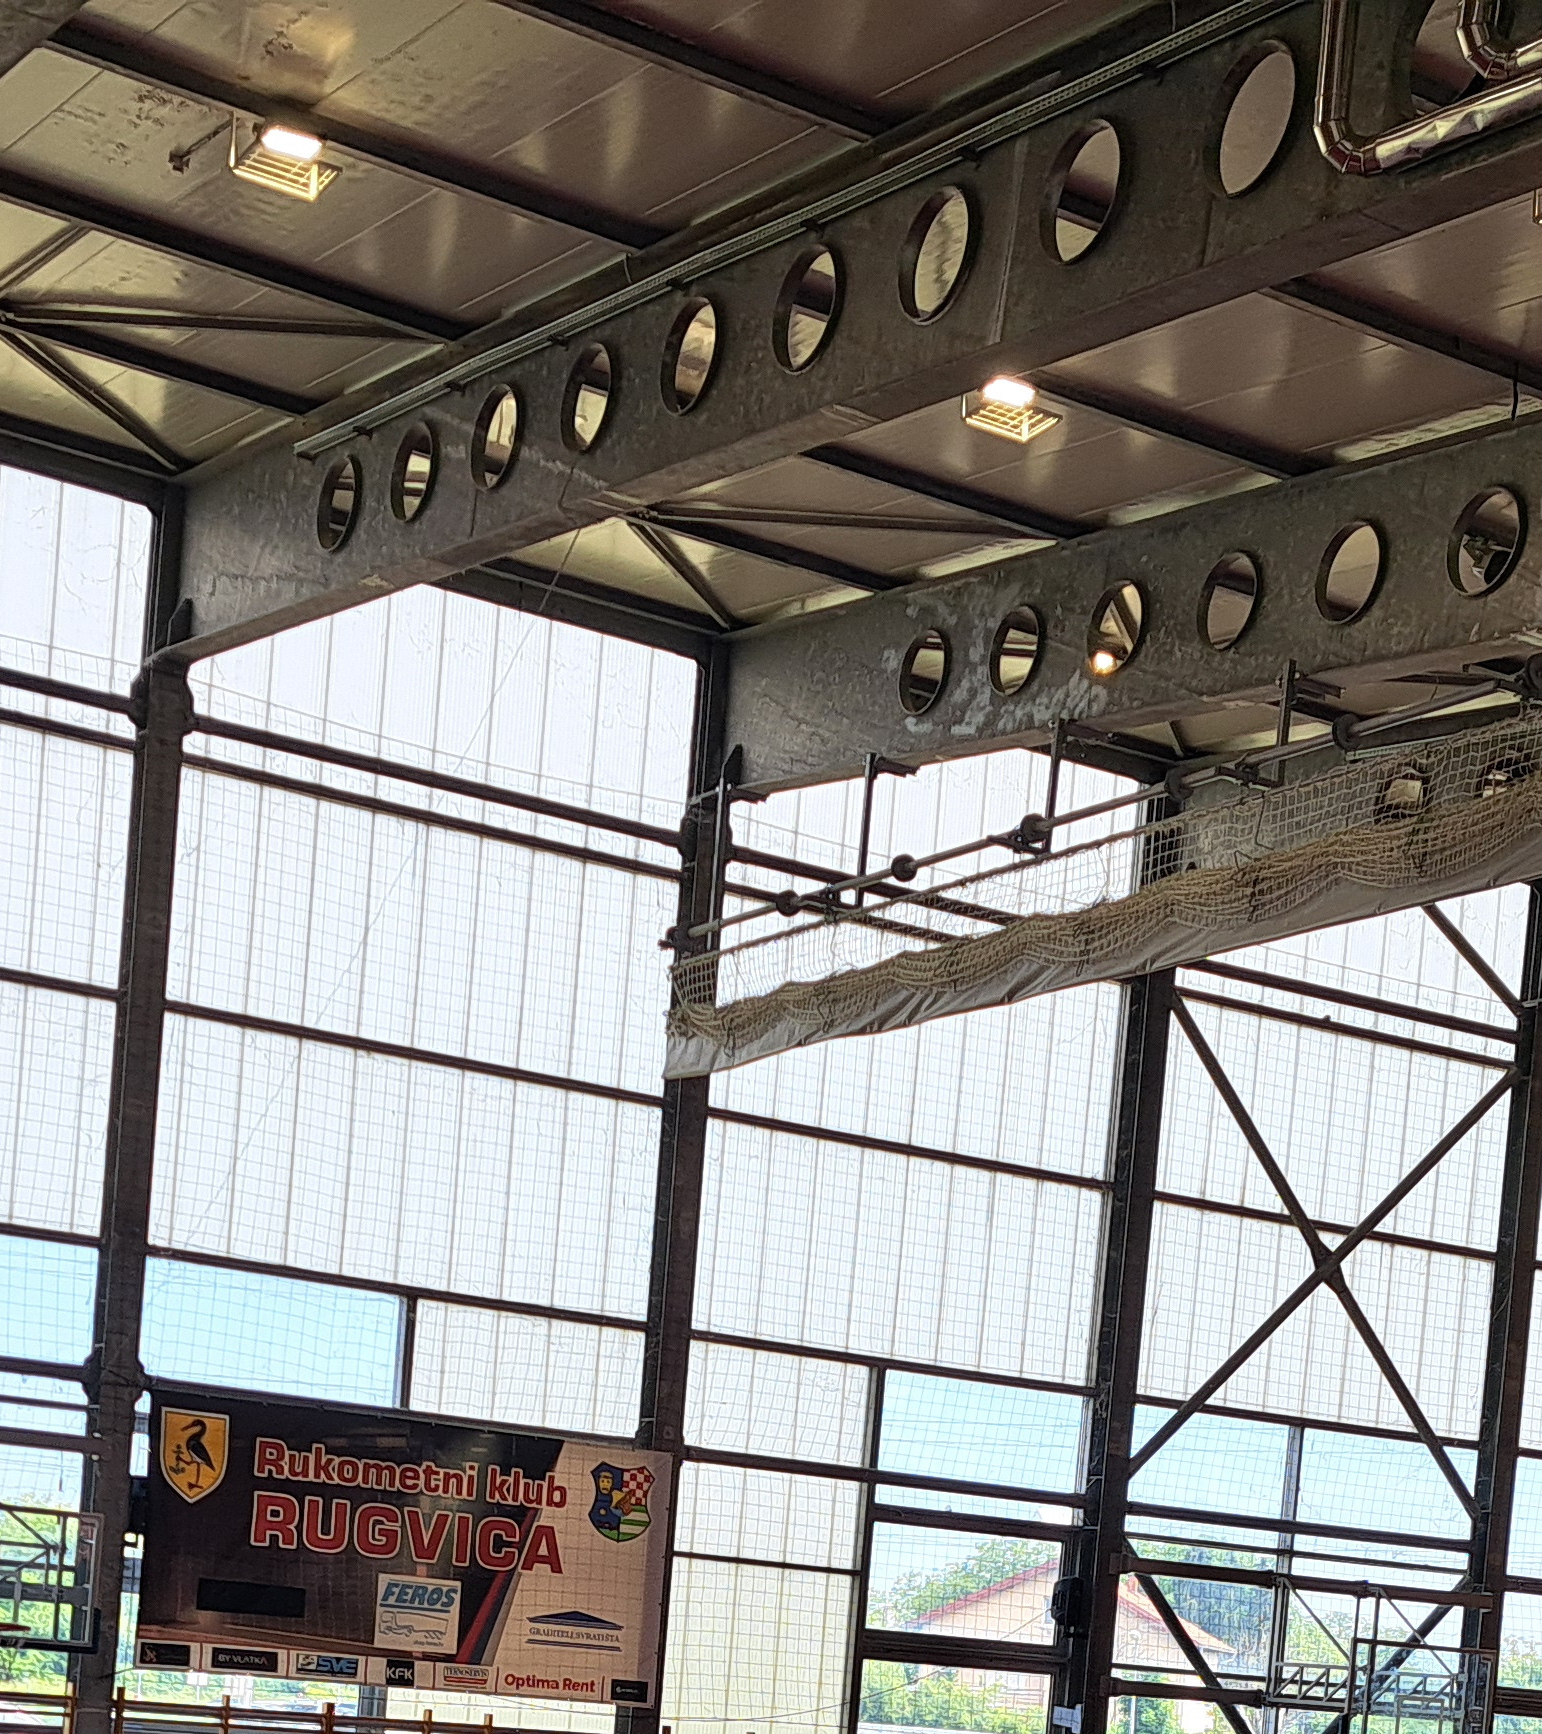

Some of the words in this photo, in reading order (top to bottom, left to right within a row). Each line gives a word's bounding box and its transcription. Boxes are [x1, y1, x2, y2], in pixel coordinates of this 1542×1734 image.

[255, 1437, 477, 1499] Rukometni
[486, 1465, 568, 1509] klub
[250, 1491, 563, 1574] RUGVICA
[381, 1582, 458, 1608] FEROS
[386, 1666, 413, 1680] KFK
[504, 1673, 559, 1690] Optima
[562, 1677, 596, 1693] Rent
